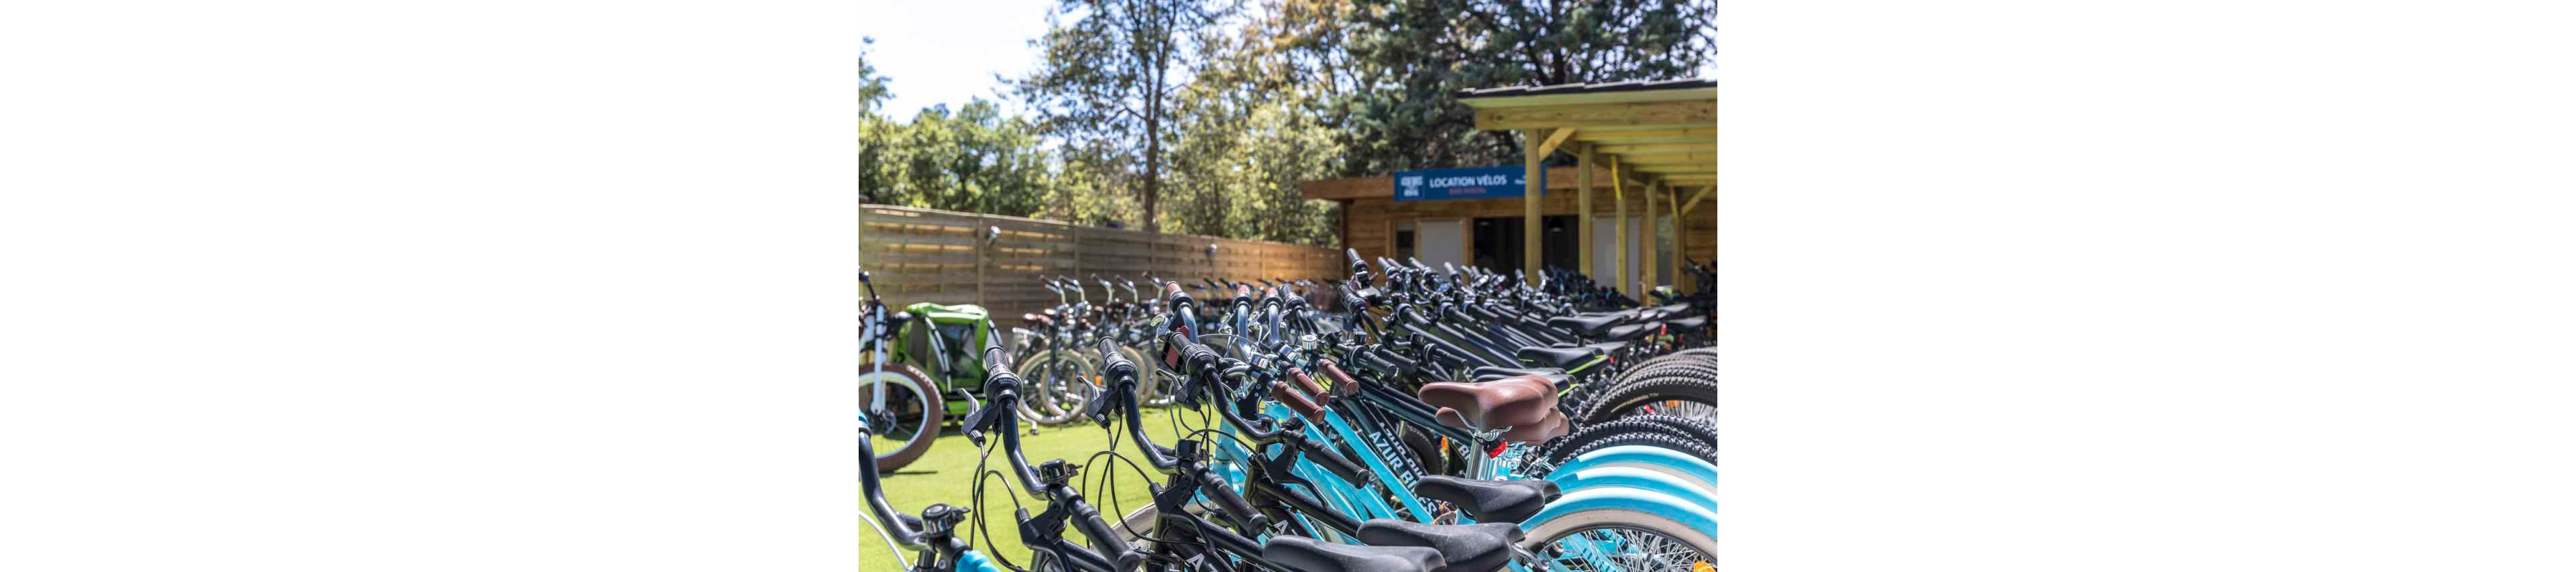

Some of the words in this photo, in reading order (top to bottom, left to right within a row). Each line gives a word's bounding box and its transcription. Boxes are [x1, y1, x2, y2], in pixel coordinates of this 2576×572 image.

[1430, 176, 1475, 188] LOCATION
[1477, 174, 1507, 186] VÉLOS
[1368, 431, 1403, 471] AZUR
